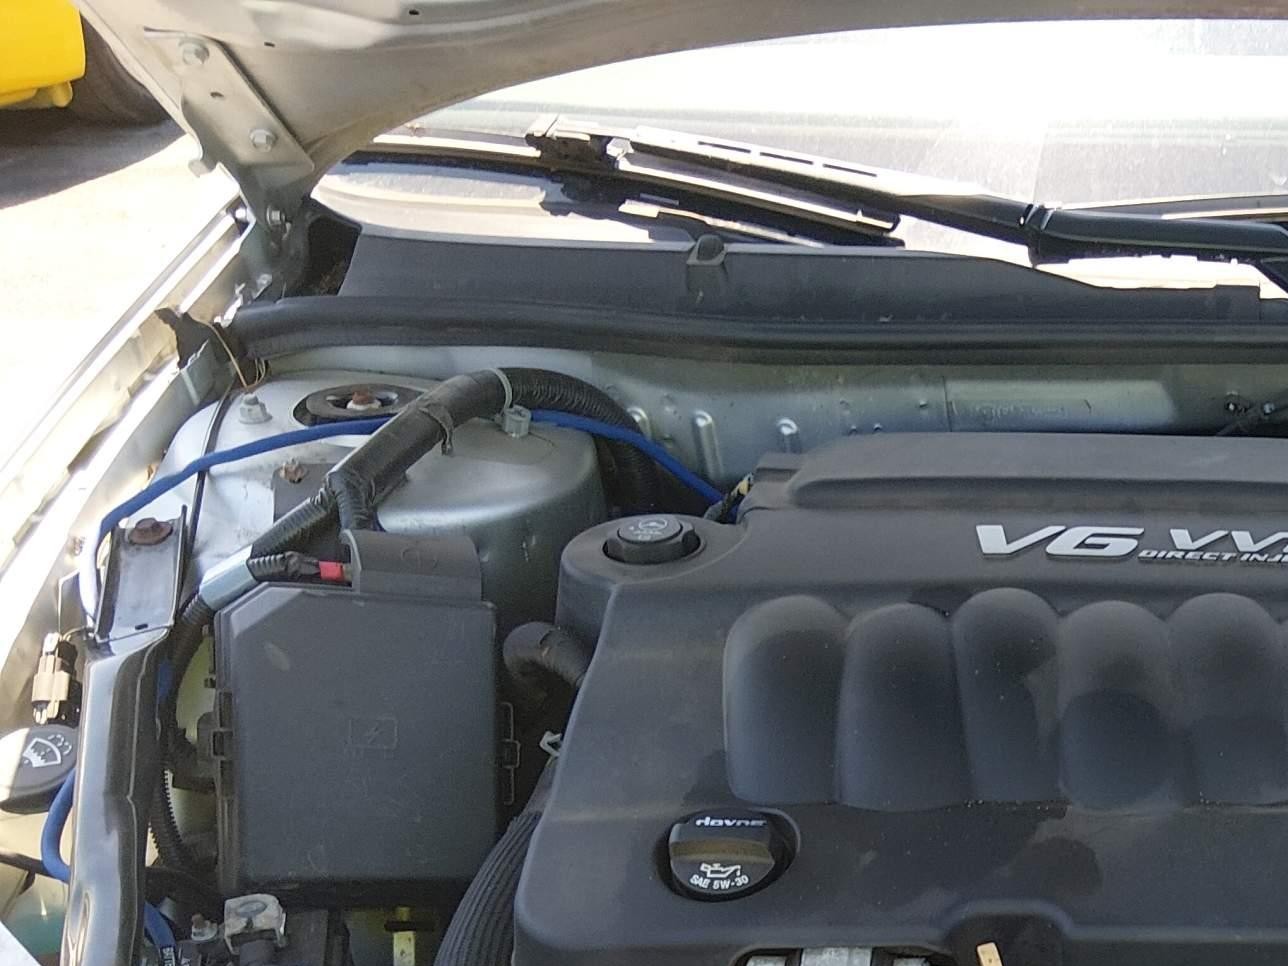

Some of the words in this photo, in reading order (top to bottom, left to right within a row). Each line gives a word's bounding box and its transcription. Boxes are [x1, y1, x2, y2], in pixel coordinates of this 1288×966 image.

[976, 524, 1145, 558] V6
[1137, 549, 1238, 562] DIRECT
[690, 874, 710, 889] SAE
[712, 874, 750, 890] 5W-30
